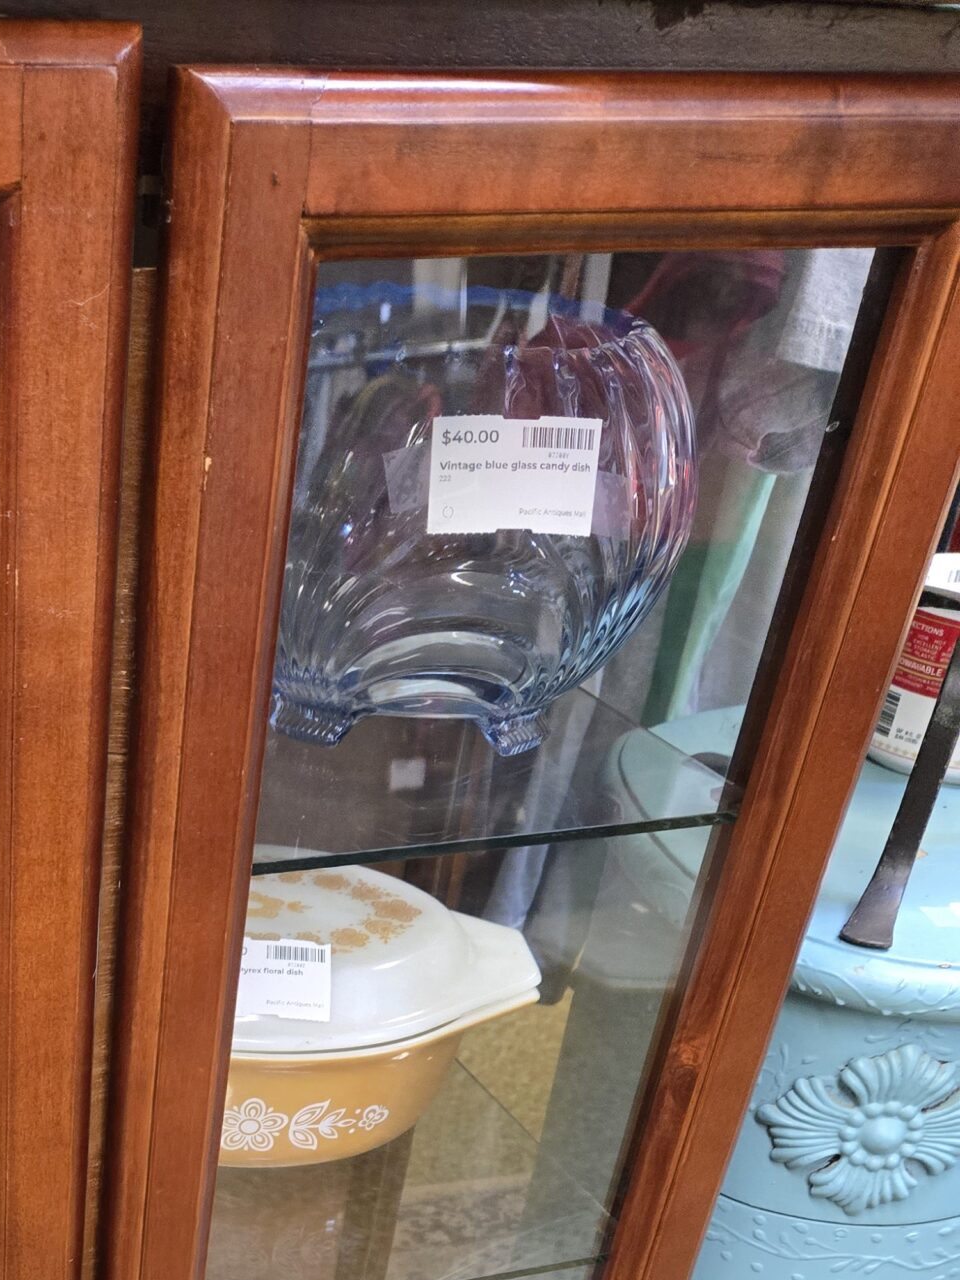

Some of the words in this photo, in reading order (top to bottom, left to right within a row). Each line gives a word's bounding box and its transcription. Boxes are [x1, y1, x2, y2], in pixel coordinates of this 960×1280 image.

[441, 429, 500, 445] $40.00
[440, 460, 482, 472] Vintage
[485, 459, 509, 469] blue
[511, 460, 538, 472] glass
[540, 460, 570, 473] candy
[572, 461, 591, 473] dish
[263, 967, 284, 975] floral
[286, 968, 304, 976] dish
